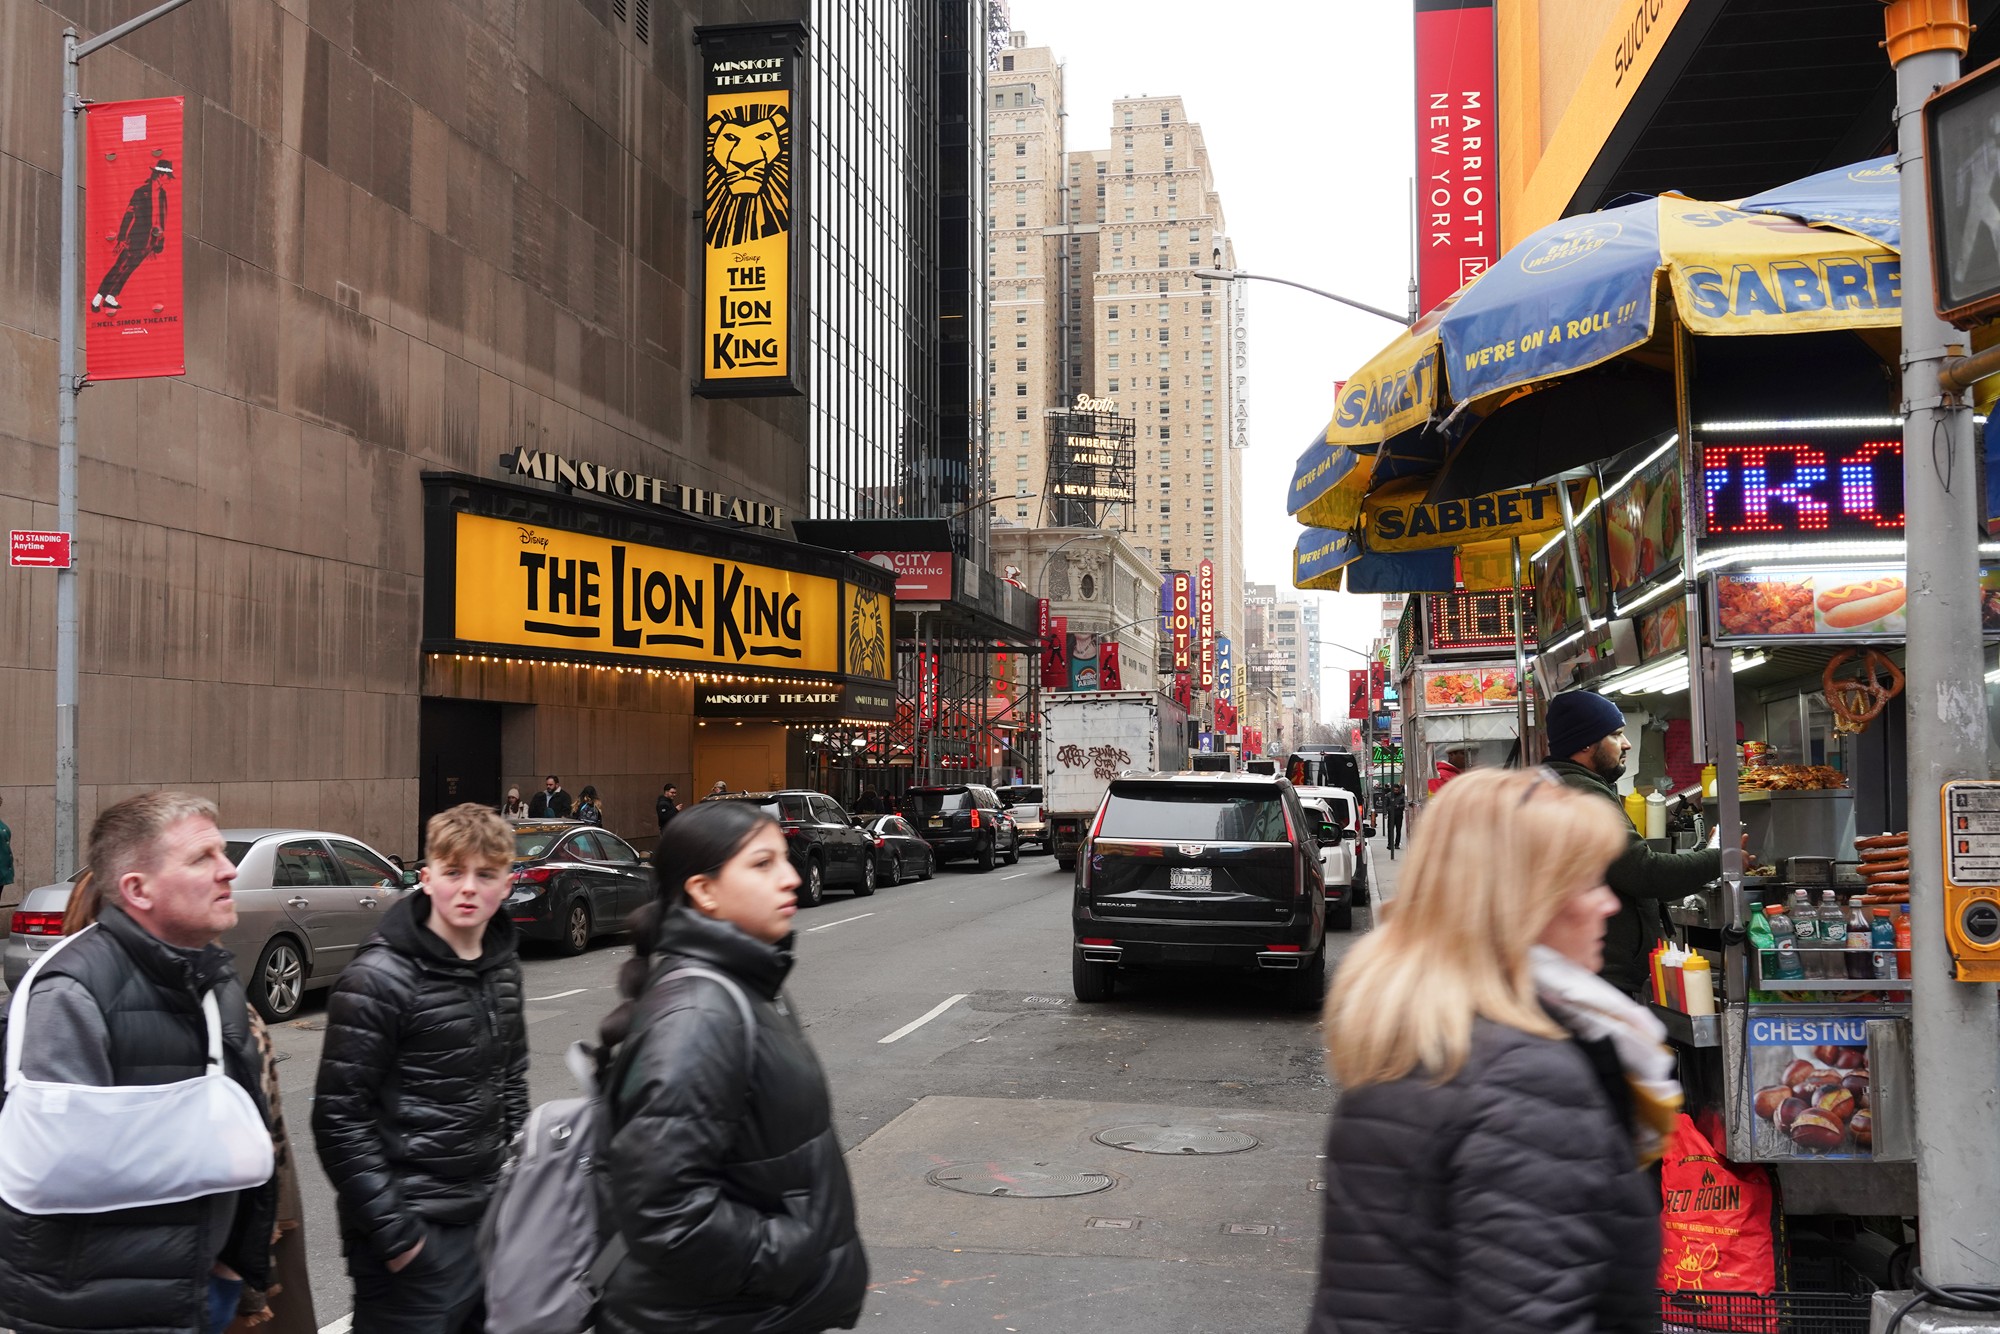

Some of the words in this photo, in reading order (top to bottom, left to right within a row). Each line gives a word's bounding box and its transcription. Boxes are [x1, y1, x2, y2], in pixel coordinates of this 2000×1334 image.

[712, 57, 784, 72] MINSKOFF
[715, 72, 782, 86] THEATRE
[1430, 93, 1449, 155] NEW
[1462, 91, 1483, 247] MARRIOTT
[1431, 169, 1451, 247] YORK
[732, 252, 761, 264] Disney
[1527, 238, 1606, 269] INSPECTED
[727, 266, 766, 286] THE
[1682, 254, 1902, 319] SABRE
[116, 318, 142, 326] SIMON
[143, 316, 178, 324] THEATRE
[1465, 339, 1516, 371] WE'RE
[1520, 329, 1545, 353] ON
[1548, 325, 1562, 344] A
[1567, 311, 1612, 340] ROLL
[1335, 343, 1437, 429] SABRETT
[1072, 393, 1115, 412] Booth
[1235, 376, 1248, 447] PLAZA
[1067, 436, 1121, 450] KIMBERLY
[1073, 453, 1114, 465] AKIMBO
[515, 447, 668, 505] MINSKOFF
[677, 483, 786, 531] THEATRE
[1054, 484, 1061, 494] A
[1064, 484, 1089, 496] NEW
[1090, 486, 1131, 499] MUSICAL
[13, 534, 25, 542] NO
[25, 534, 62, 543] STANDING
[13, 542, 45, 551] Anytime
[517, 527, 550, 551] Disney
[894, 554, 931, 567] CITY
[894, 567, 944, 576] PARKING
[1729, 575, 1768, 584] CHICKEN
[519, 551, 601, 618] THE
[1175, 577, 1188, 667] BOOTH
[1201, 565, 1213, 685] SCHOENFELD
[1219, 644, 1231, 706] JACO
[704, 694, 770, 704] MINSKOFF
[778, 693, 839, 703] THEATRE
[1752, 1021, 1866, 1042] CHESTNU
[1694, 1185, 1740, 1211] ROBIN
